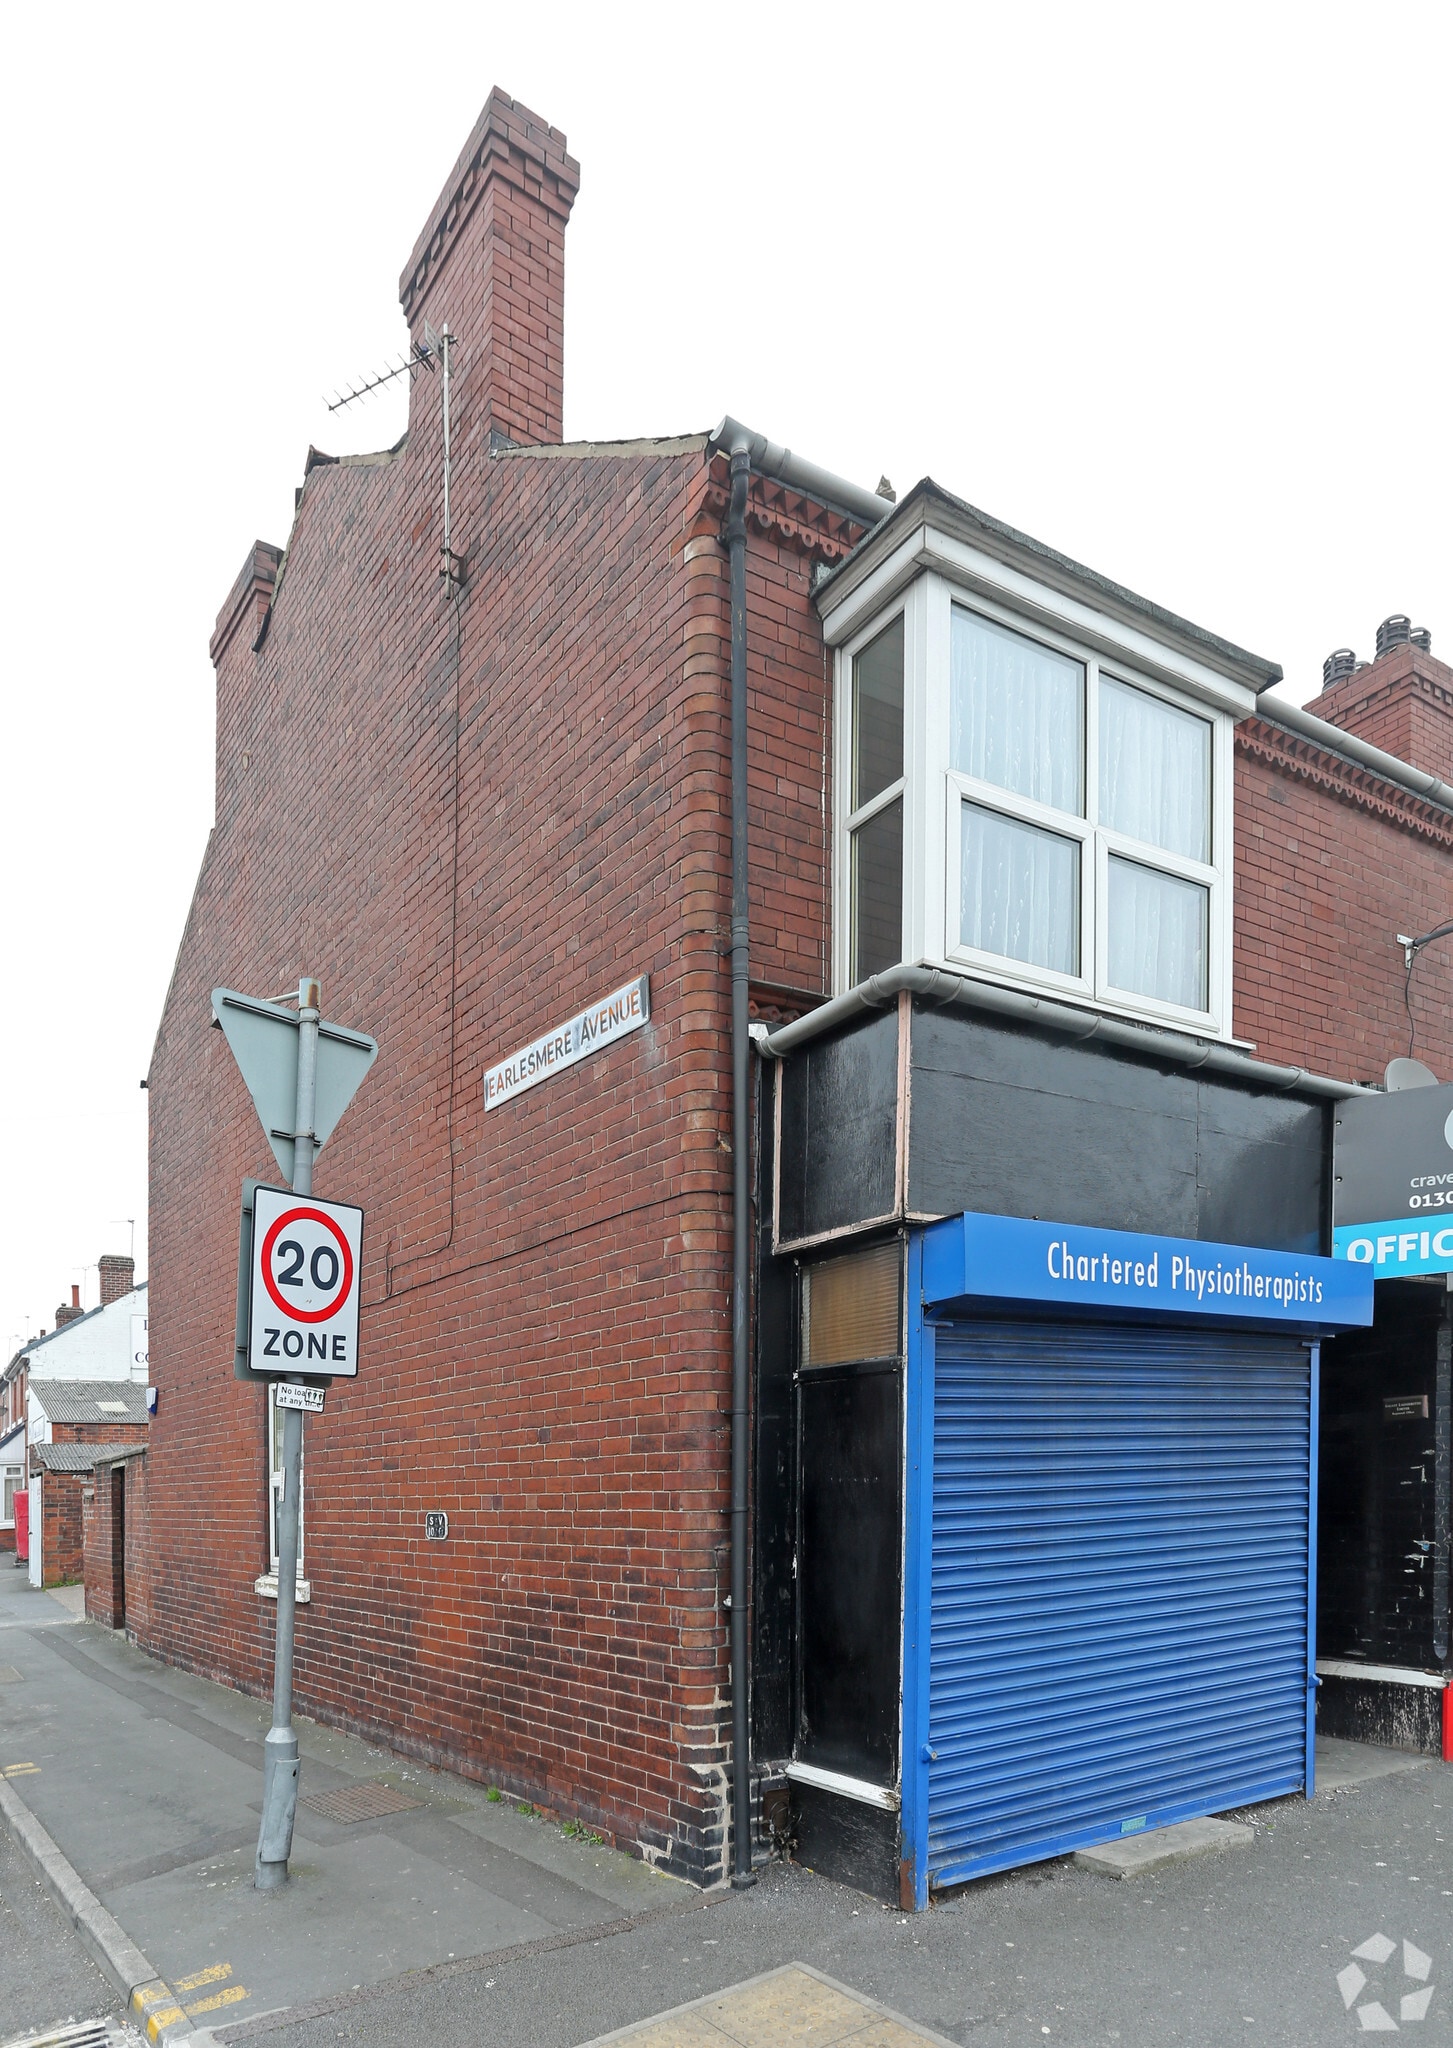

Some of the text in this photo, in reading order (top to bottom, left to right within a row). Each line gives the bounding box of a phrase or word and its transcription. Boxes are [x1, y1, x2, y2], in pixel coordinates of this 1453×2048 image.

[488, 990, 640, 1098] EARLESMERE AVENUE
[277, 1239, 339, 1291] 20
[1047, 1241, 1323, 1307] Chartered Physiotherapists
[263, 1328, 347, 1361] ZONE
[281, 1386, 292, 1395] No
[289, 1398, 303, 1406] any
